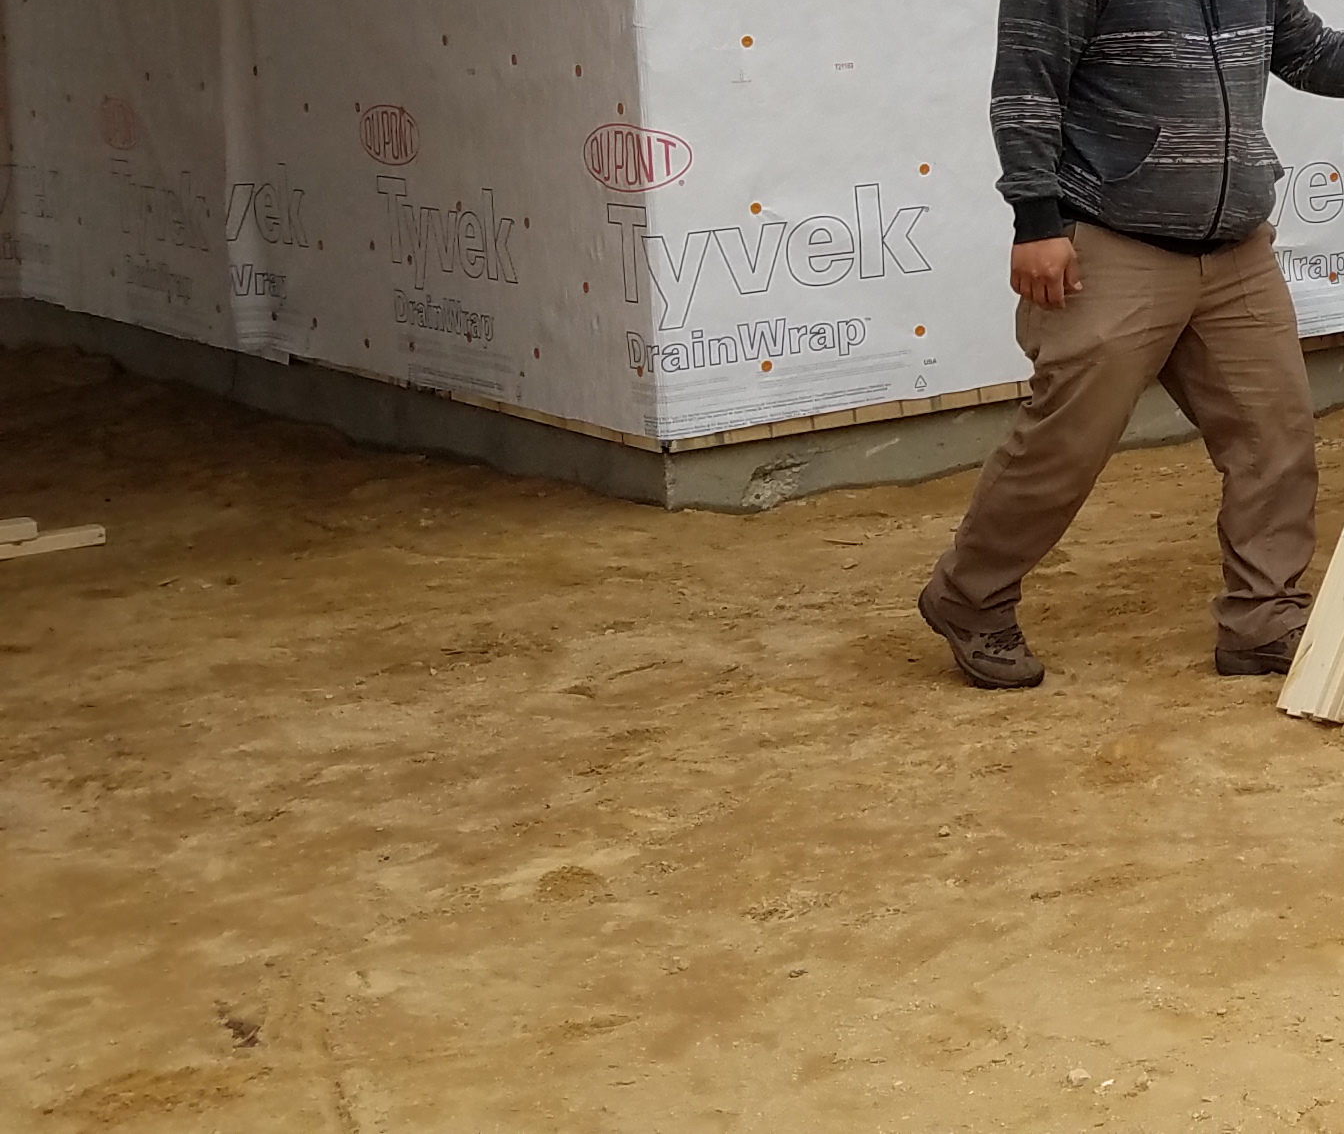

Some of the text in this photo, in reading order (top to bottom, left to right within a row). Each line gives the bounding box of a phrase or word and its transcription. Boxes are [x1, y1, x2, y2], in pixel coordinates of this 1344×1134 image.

[376, 174, 519, 291] Tyvek
[606, 183, 932, 331] Tyvek
[393, 288, 495, 349] DrainWrap
[626, 316, 867, 374] DrainWrap
